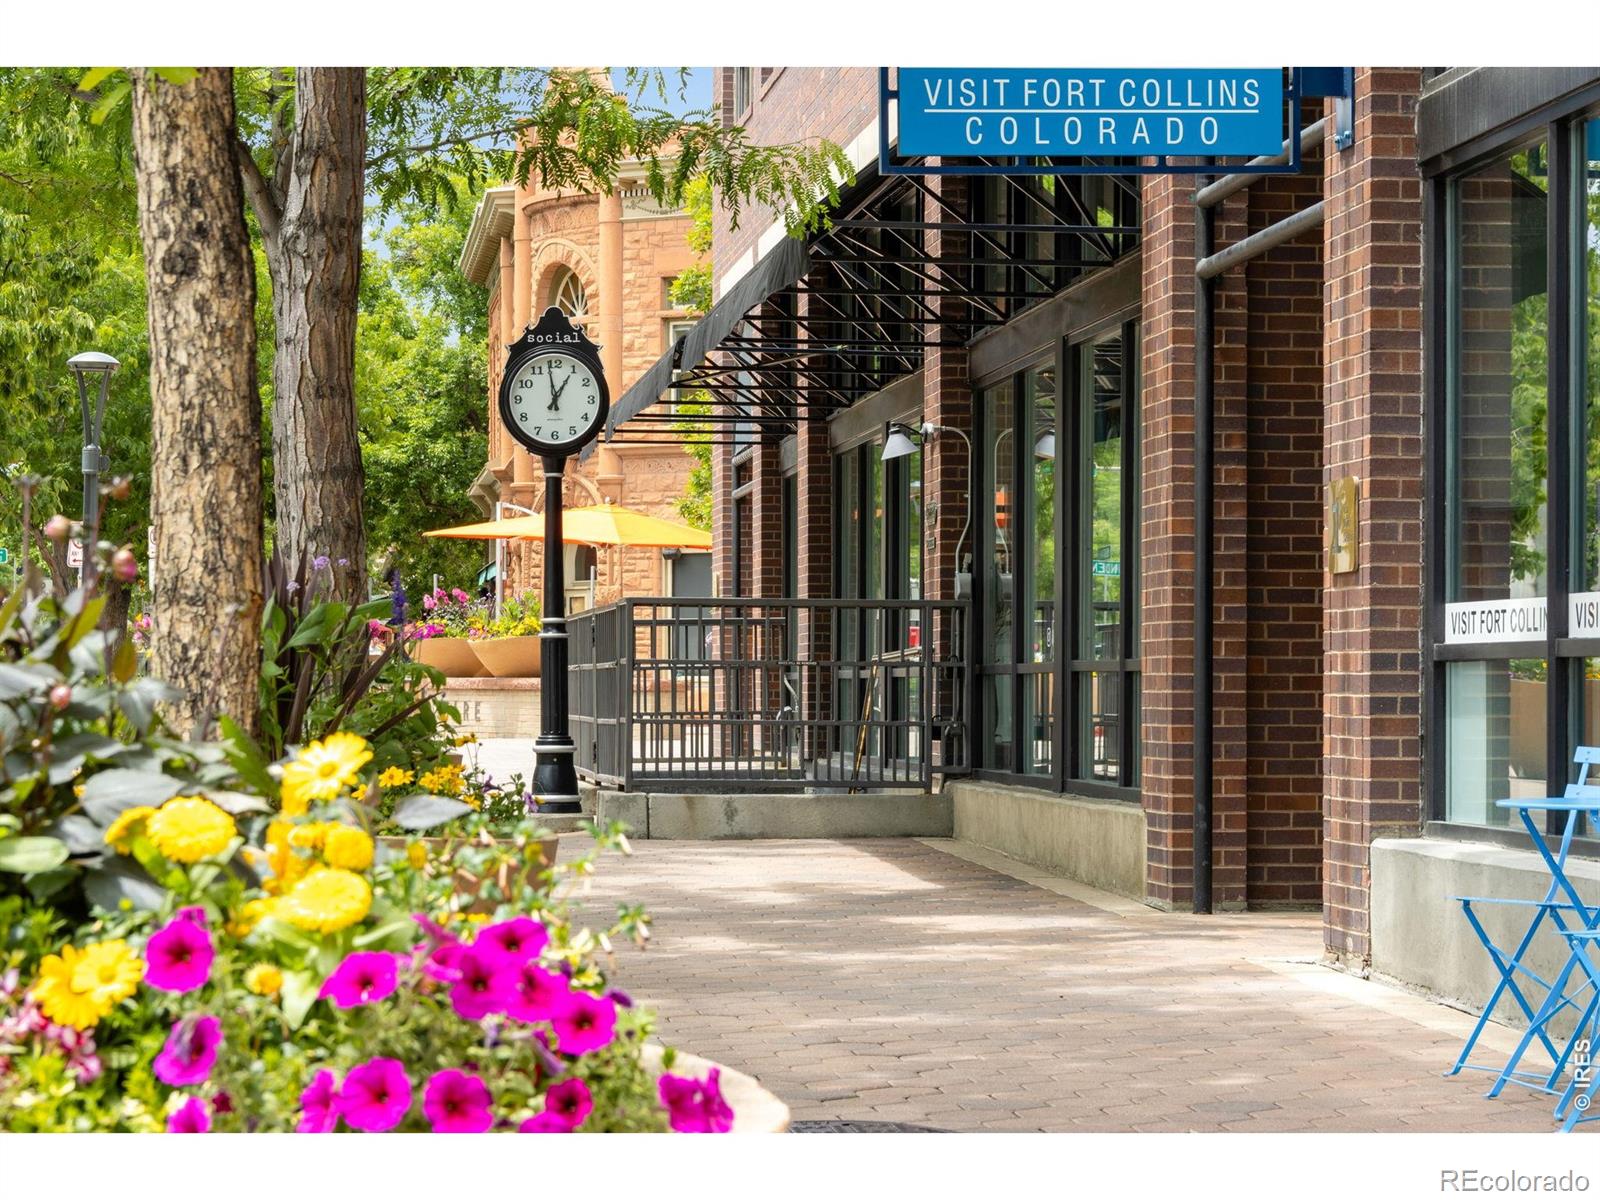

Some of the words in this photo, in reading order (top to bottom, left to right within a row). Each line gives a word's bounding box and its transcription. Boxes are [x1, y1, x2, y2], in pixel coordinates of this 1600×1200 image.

[924, 78, 1010, 107] VISIT
[1024, 78, 1106, 107] FORT
[1119, 78, 1260, 107] COLLINS
[965, 116, 1219, 145] COLORADO
[527, 332, 580, 343] social
[547, 360, 563, 369] 12
[570, 365, 577, 374] 1
[530, 366, 544, 375] 11
[519, 379, 533, 389] 10
[582, 377, 590, 387] 2
[514, 394, 522, 404] 9
[587, 394, 595, 404] 3
[519, 412, 528, 422] 8
[581, 412, 589, 422] 4
[534, 426, 542, 436] 7
[551, 431, 559, 440] 6
[569, 426, 577, 435] 5
[1451, 611, 1477, 635] VISIT
[1480, 609, 1507, 634] FORT
